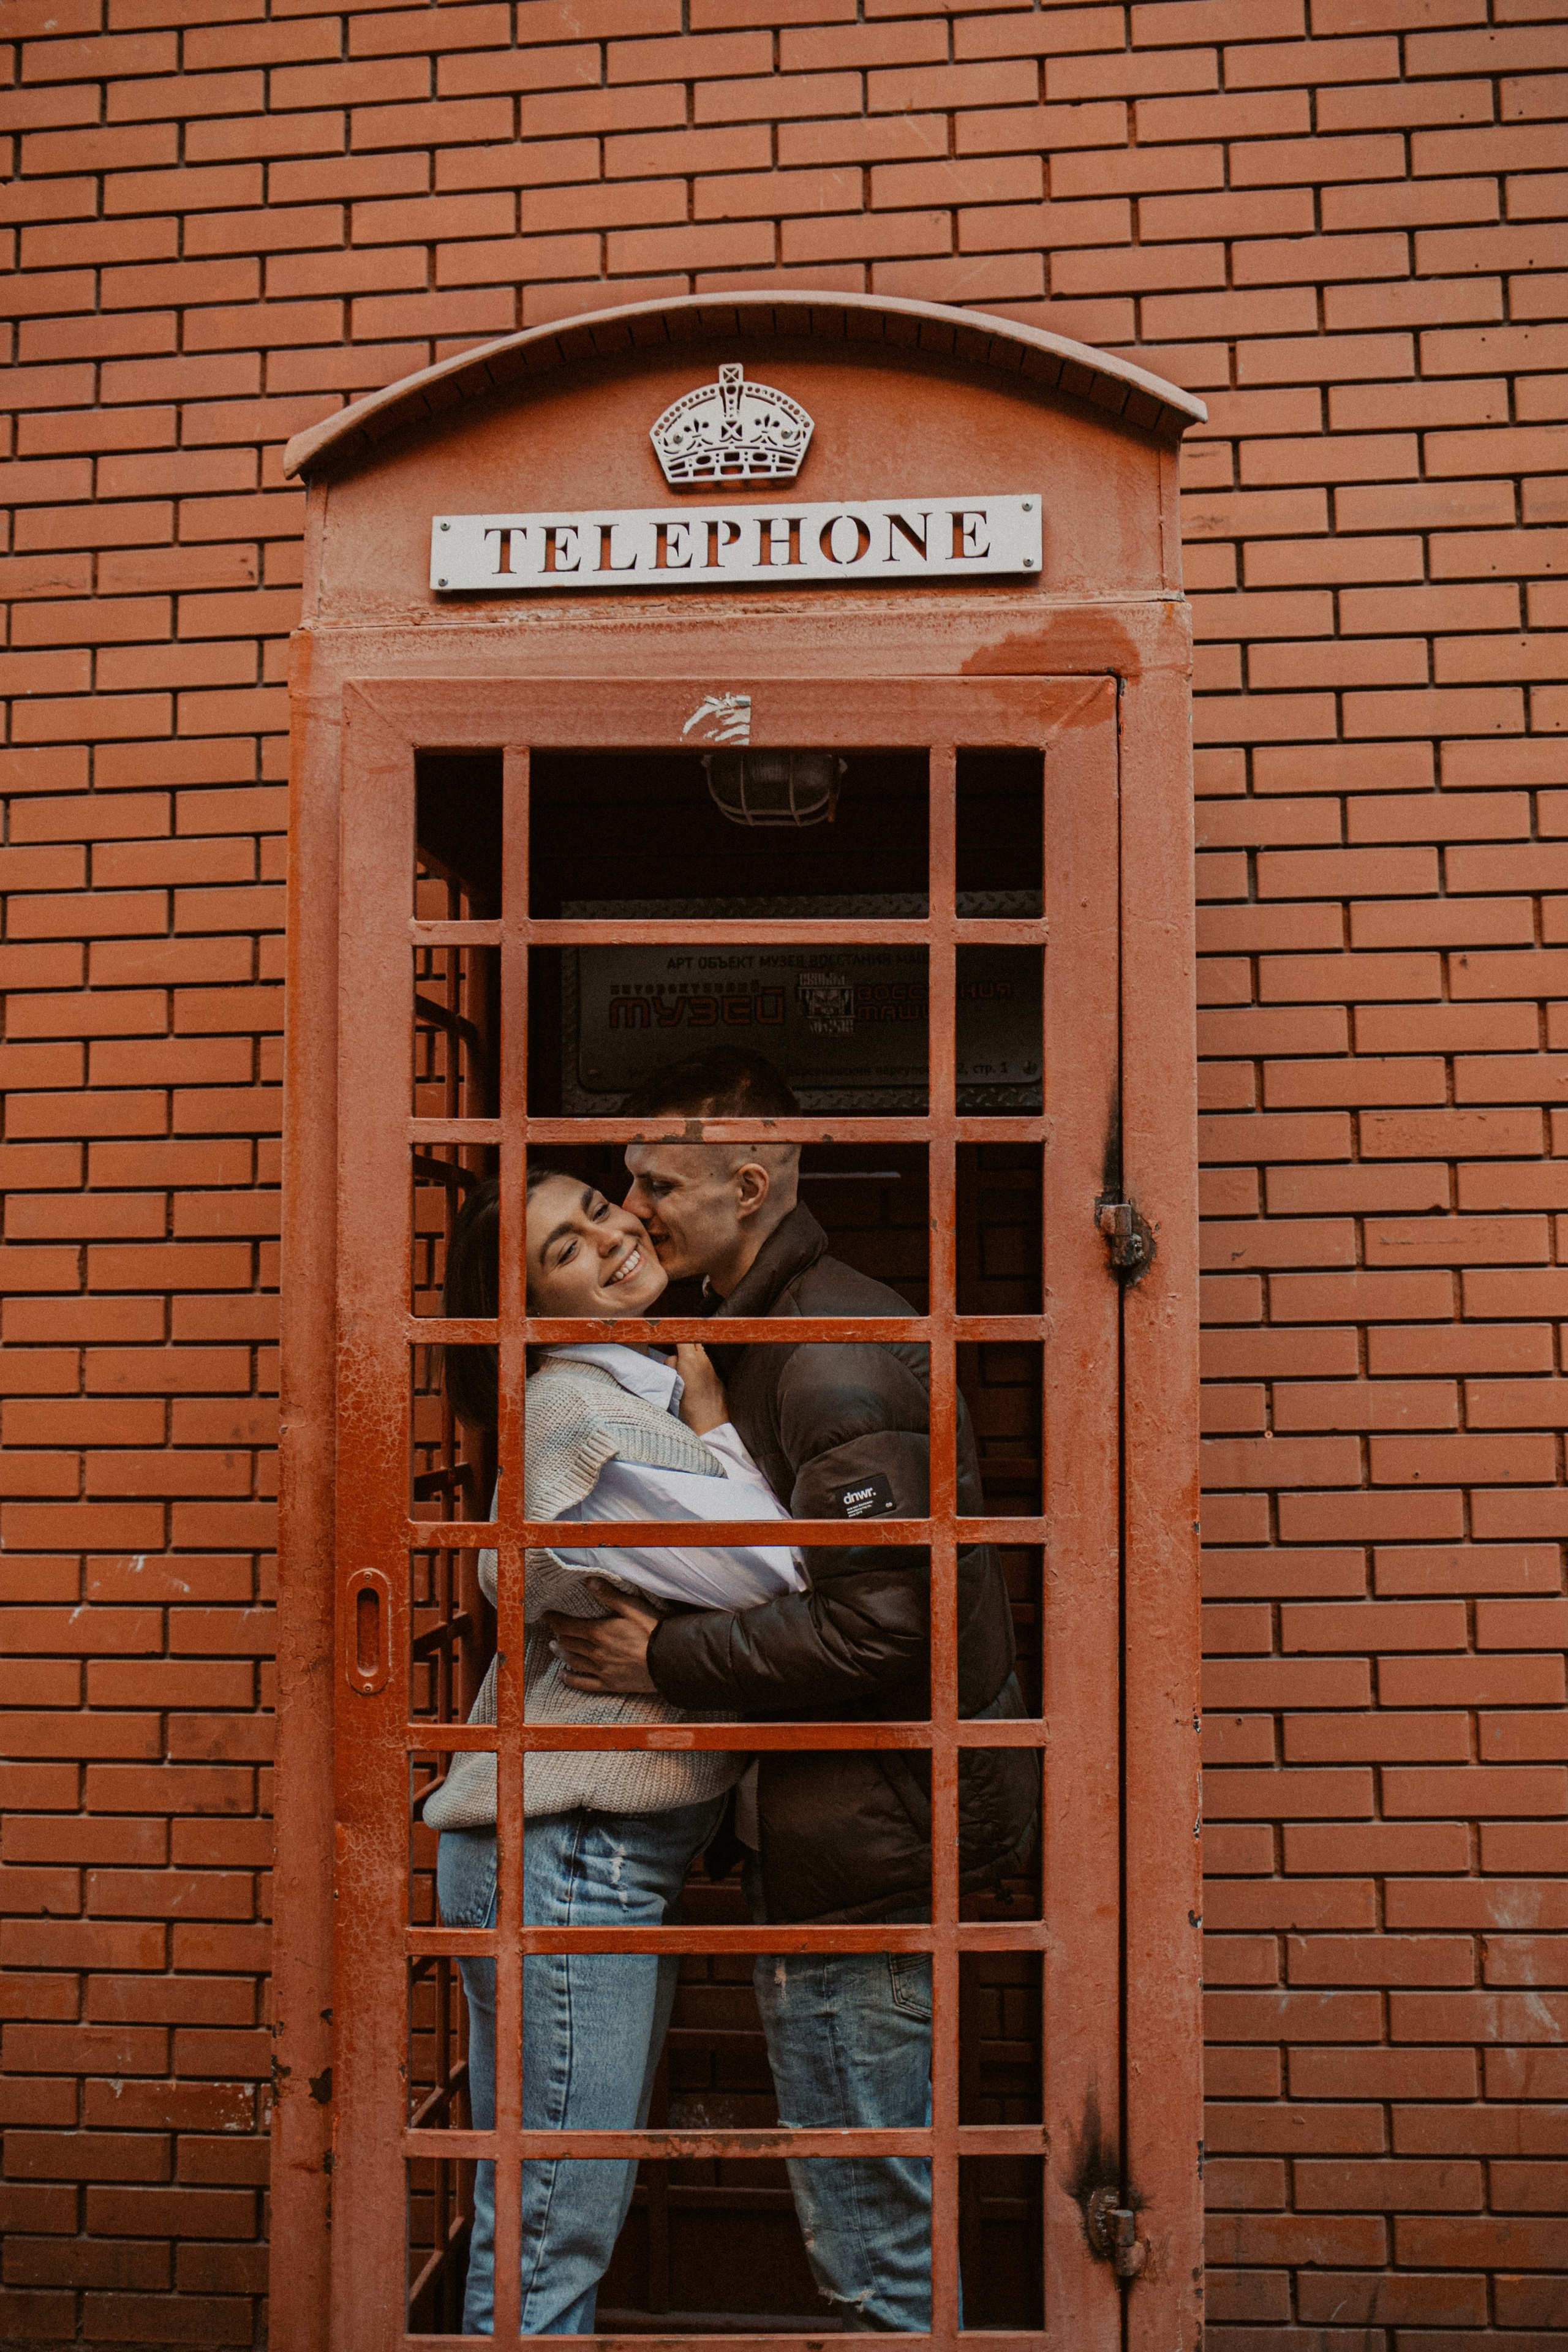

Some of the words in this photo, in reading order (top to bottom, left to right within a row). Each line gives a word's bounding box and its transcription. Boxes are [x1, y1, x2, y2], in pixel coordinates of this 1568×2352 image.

[483, 510, 991, 575] TELEPHONE
[667, 956, 694, 970] АРТ
[698, 955, 755, 968] ОБЪЕКТ
[857, 981, 1012, 1001] ВОССНИЯ
[609, 986, 785, 1028] МУЗЕЙ
[843, 1487, 876, 1504] dnwr.
